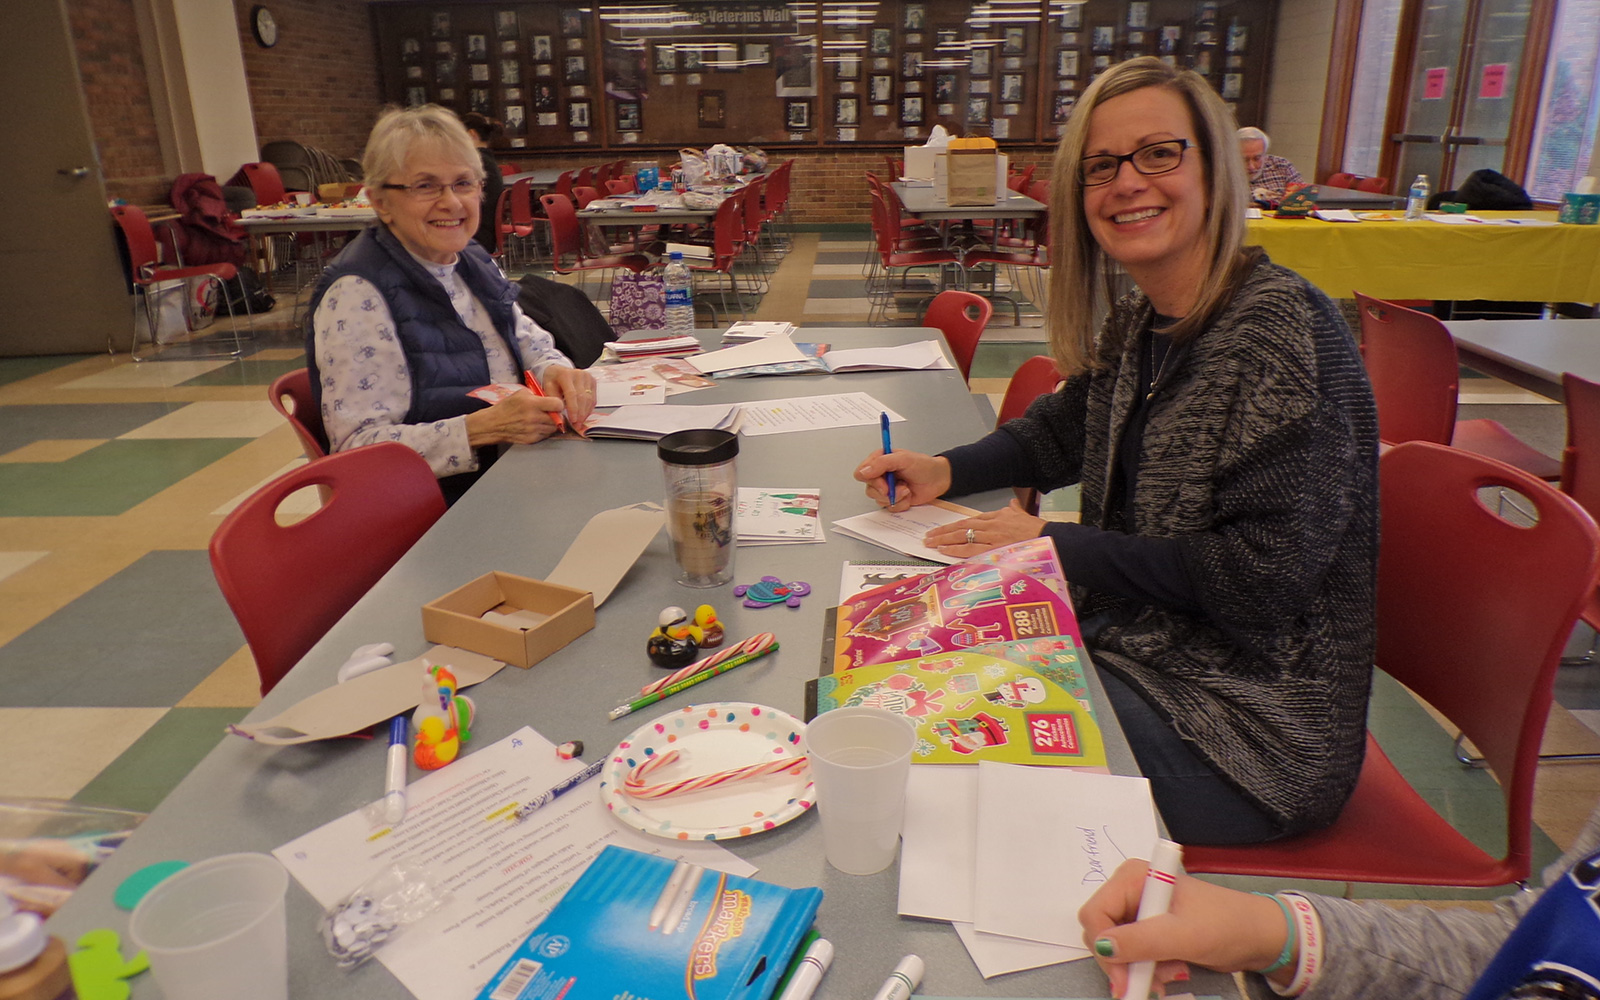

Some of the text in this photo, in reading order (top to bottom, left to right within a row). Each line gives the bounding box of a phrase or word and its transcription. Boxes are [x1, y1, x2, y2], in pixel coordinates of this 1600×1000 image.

[709, 10, 761, 23] Veterans
[763, 9, 790, 22] Wall
[1013, 610, 1033, 635] 288
[1032, 719, 1053, 747] 276
[677, 900, 699, 934] broad tip
[733, 895, 750, 937] washable
[1303, 913, 1316, 947] SOCCER
[547, 938, 562, 954] AP
[694, 893, 738, 975] markers
